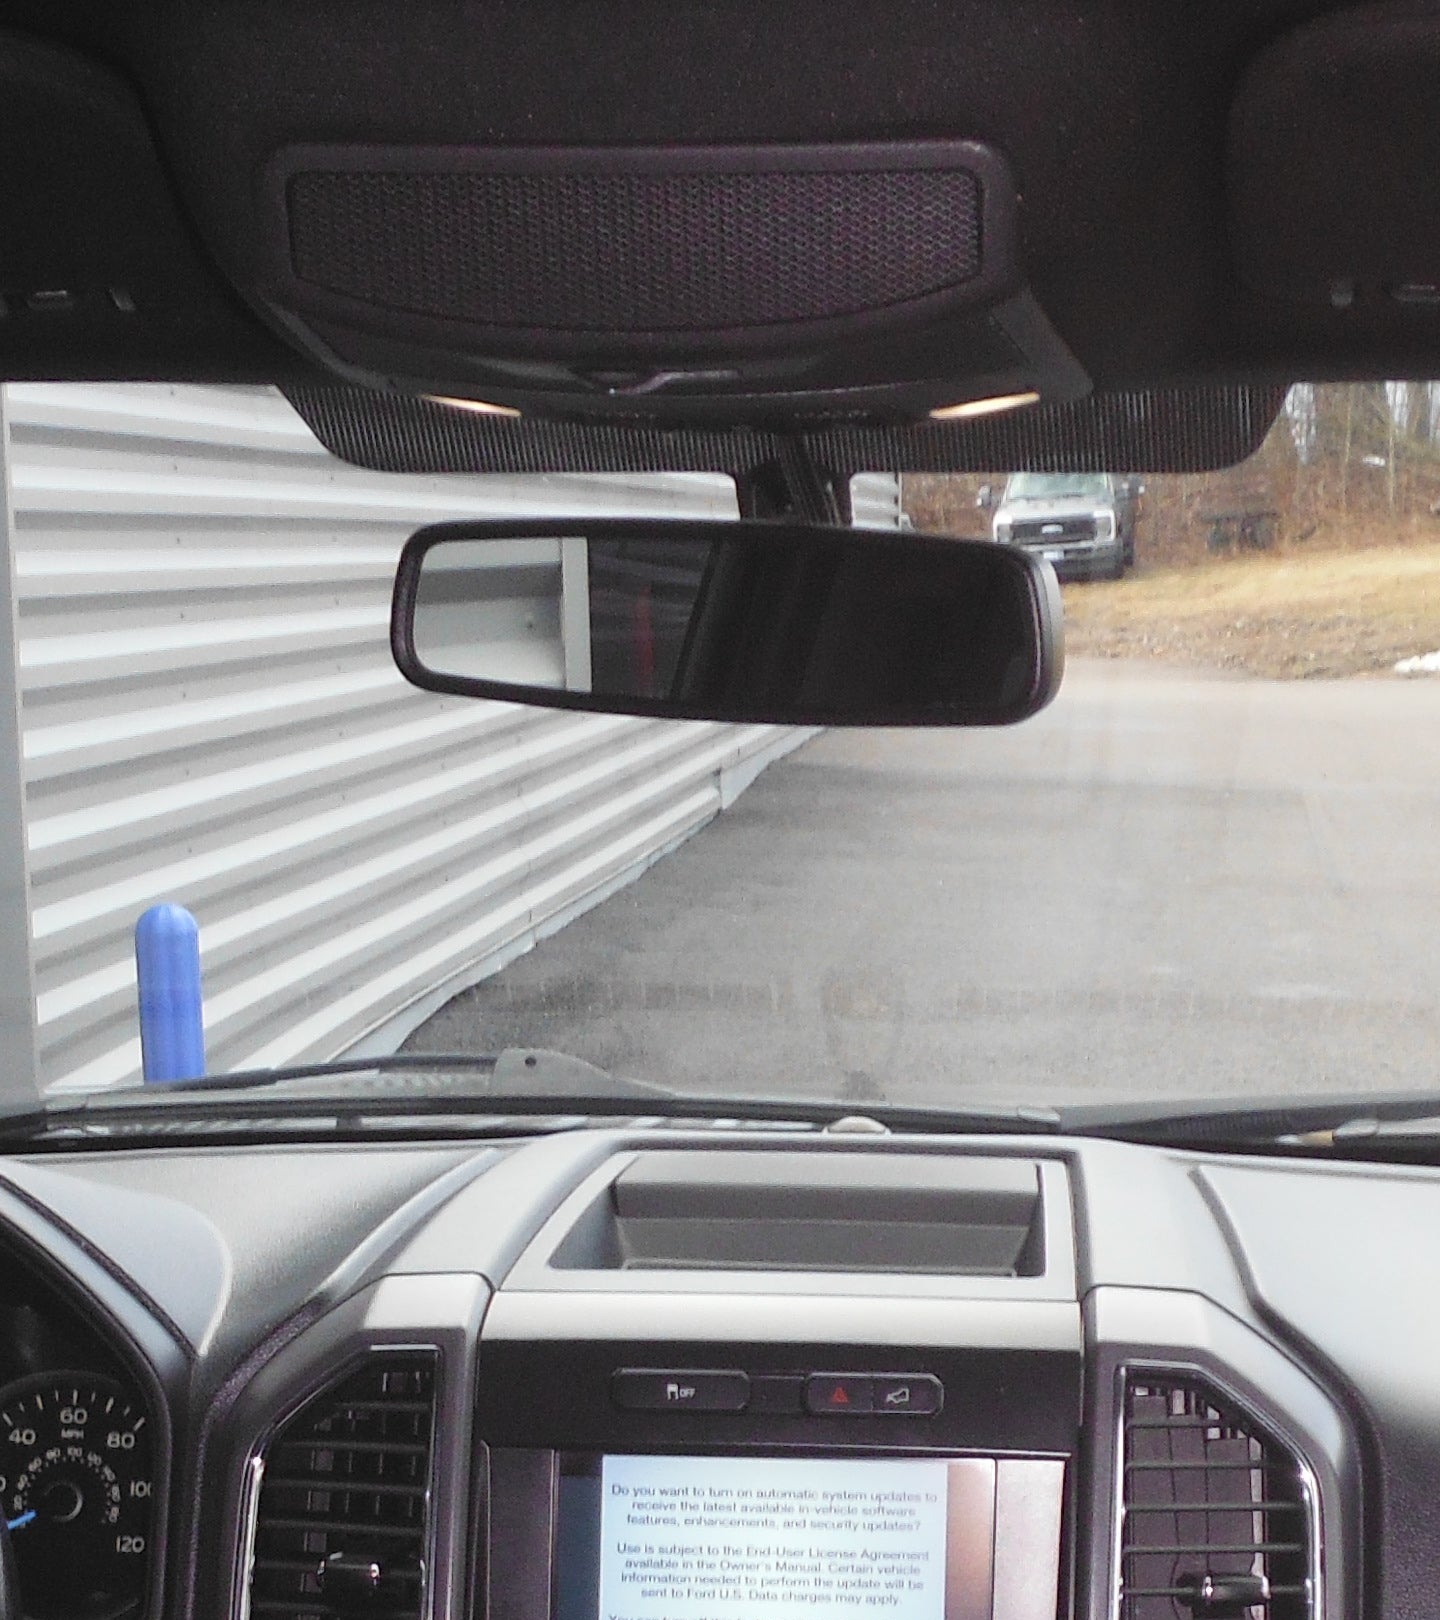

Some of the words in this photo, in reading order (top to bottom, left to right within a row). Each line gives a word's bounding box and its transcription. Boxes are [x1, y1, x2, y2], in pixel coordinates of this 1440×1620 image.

[60, 1409, 88, 1425] 60
[9, 1429, 36, 1445] 40
[61, 1429, 84, 1440] MPH
[107, 1432, 135, 1449] 80
[611, 1483, 629, 1497] Do
[633, 1486, 655, 1498] you
[660, 1487, 689, 1498] want
[693, 1486, 705, 1498] to
[709, 1487, 733, 1498] turn
[737, 1489, 753, 1499] on
[756, 1488, 816, 1500] automatic
[822, 1490, 867, 1502] system
[871, 1491, 921, 1504] updates
[926, 1492, 938, 1503] to
[632, 1501, 677, 1512] receive
[680, 1501, 699, 1512] the
[703, 1502, 736, 1513] latest
[740, 1503, 794, 1514] available
[862, 1505, 916, 1516] software
[783, 1519, 807, 1529] and
[116, 1536, 145, 1553] 120
[617, 1541, 641, 1555] Use
[644, 1543, 654, 1555] is
[658, 1544, 703, 1558] subject
[707, 1544, 719, 1556] to
[723, 1545, 743, 1556] the
[809, 1547, 857, 1559] License
[860, 1548, 929, 1562] Agreement
[625, 1559, 678, 1570] available
[682, 1559, 693, 1570] in
[697, 1559, 716, 1570] the
[828, 1563, 874, 1575] Certain
[877, 1565, 921, 1576] vehicle
[745, 1575, 757, 1586] to
[814, 1577, 833, 1588] the
[641, 1588, 667, 1598] sent
[671, 1588, 683, 1599] to
[687, 1588, 716, 1599] Ford
[748, 1590, 778, 1601] Data
[835, 1593, 862, 1605] may
